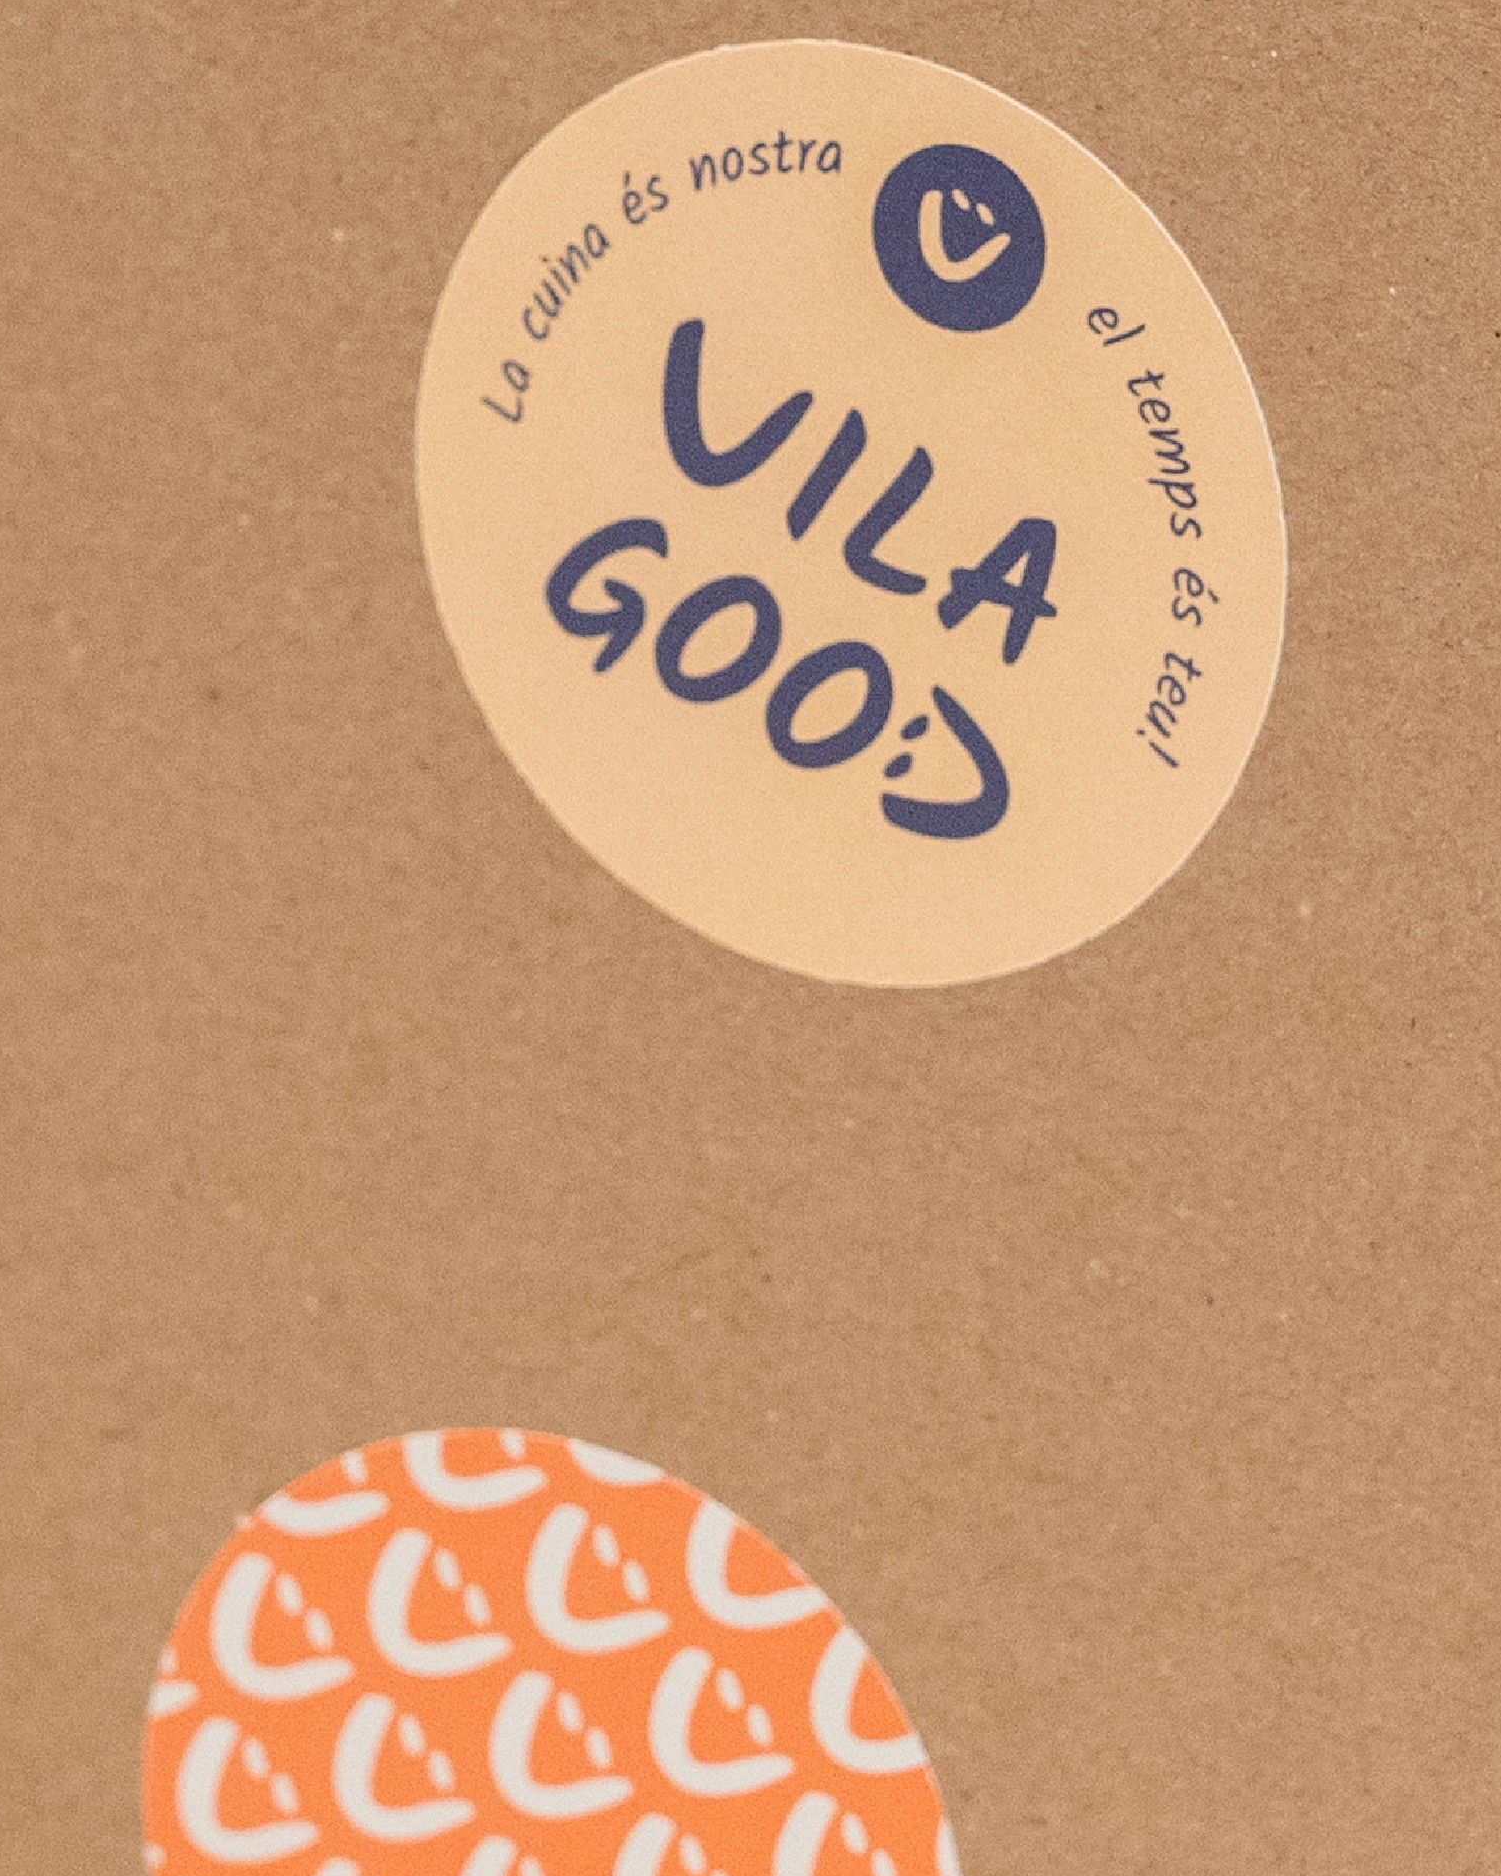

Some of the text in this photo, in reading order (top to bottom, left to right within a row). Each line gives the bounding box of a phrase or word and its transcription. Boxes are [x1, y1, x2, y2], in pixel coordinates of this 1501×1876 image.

[480, 129, 845, 425] La cuina és nostra
[660, 316, 1059, 667] VILA
[1085, 304, 1221, 770] el temps és teu!
